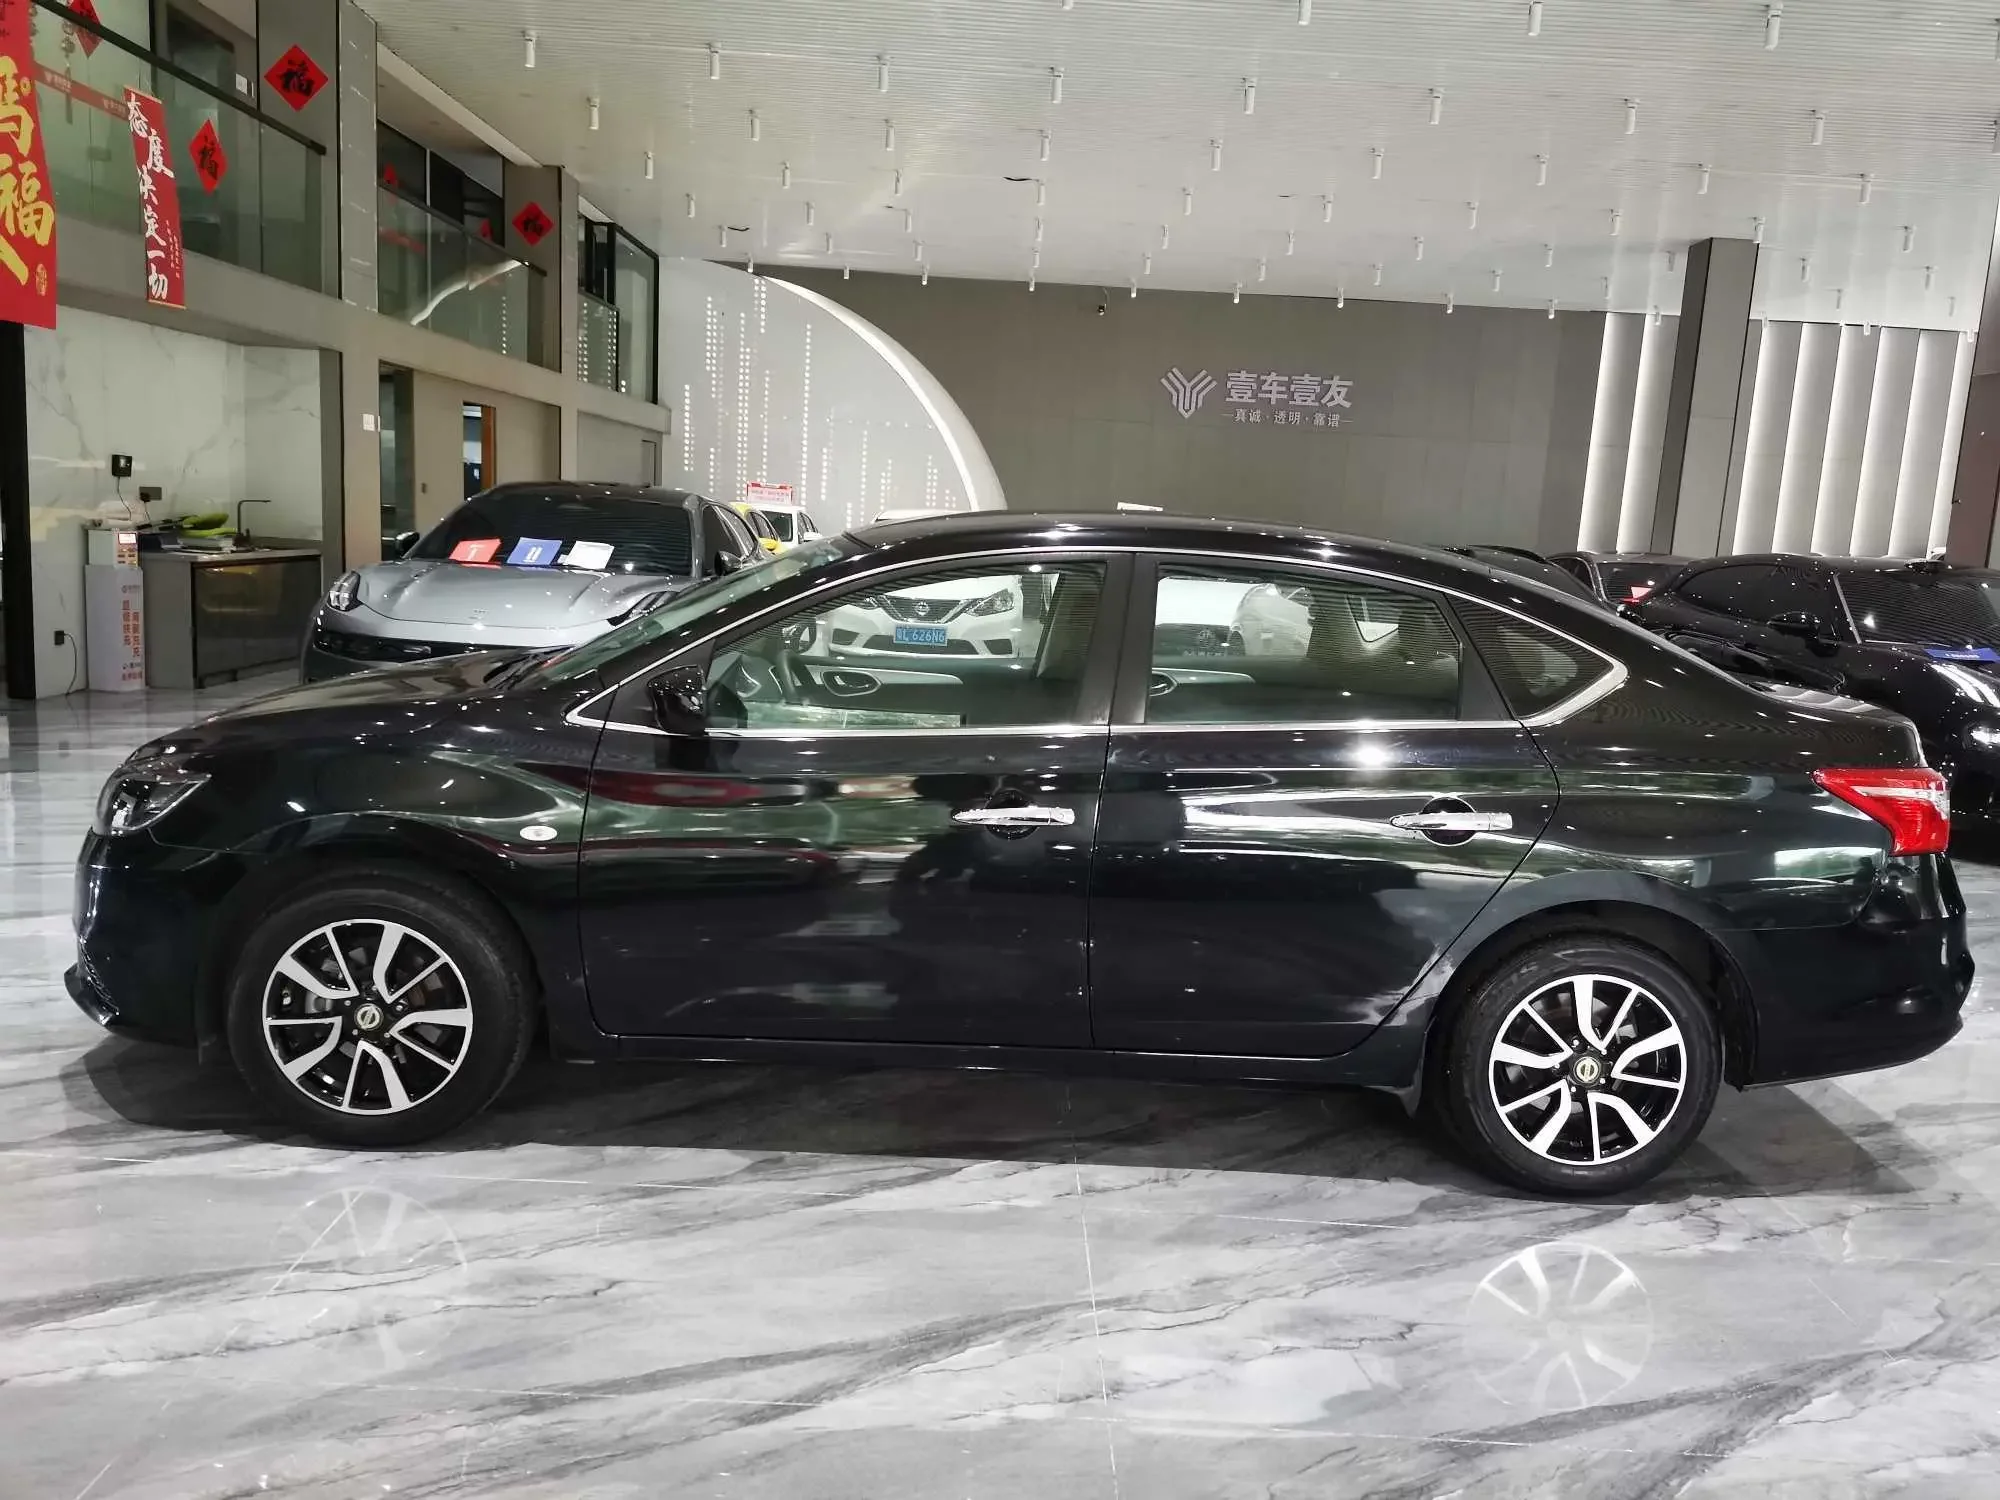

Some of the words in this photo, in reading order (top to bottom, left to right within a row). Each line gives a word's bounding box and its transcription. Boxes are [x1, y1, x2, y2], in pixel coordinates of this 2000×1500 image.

[277, 59, 315, 97] 福
[127, 92, 175, 300] 态度决定一切
[1225, 370, 1354, 408] 壹车壹友
